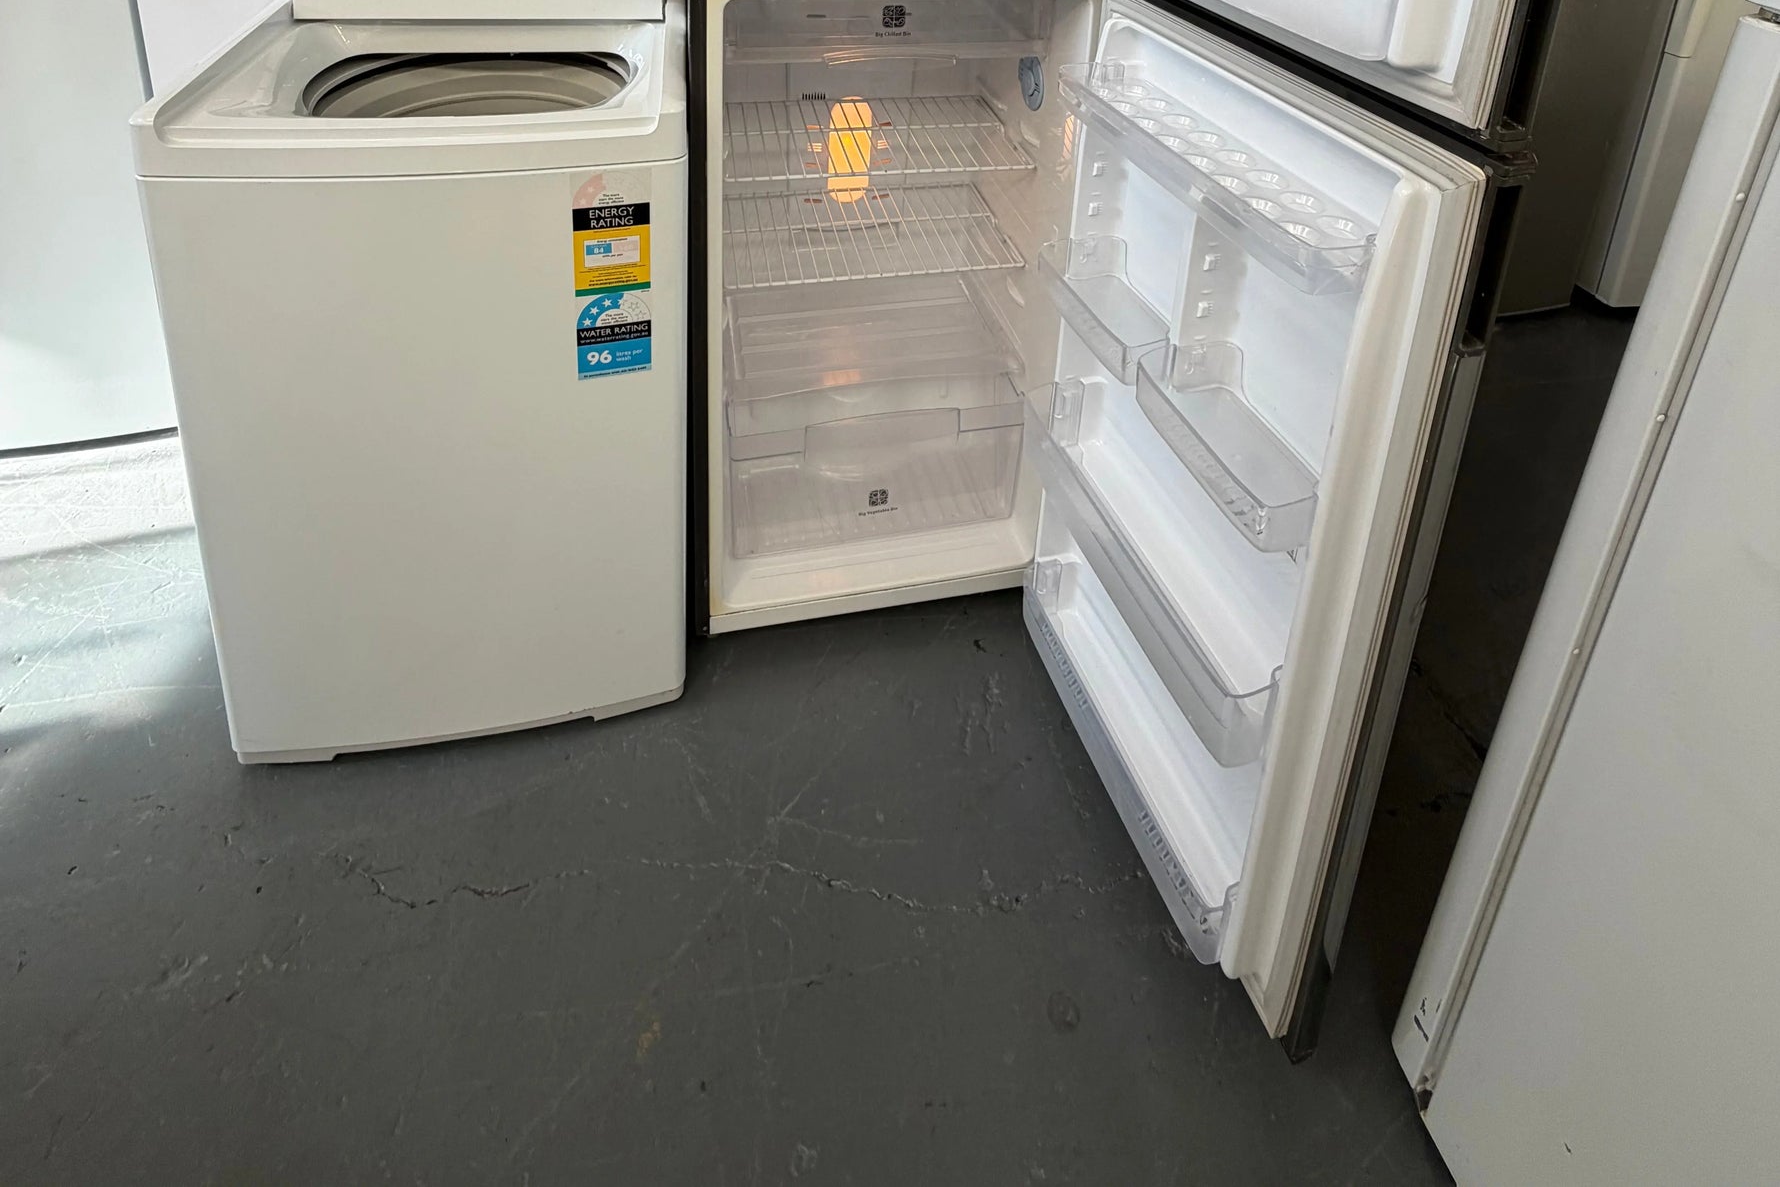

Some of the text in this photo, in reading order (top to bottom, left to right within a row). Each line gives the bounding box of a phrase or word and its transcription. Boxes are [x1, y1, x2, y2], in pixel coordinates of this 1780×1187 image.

[589, 206, 635, 219] ENERGY
[590, 216, 633, 229] RATING
[580, 323, 648, 338] WATER RATING
[586, 350, 612, 365] 96
